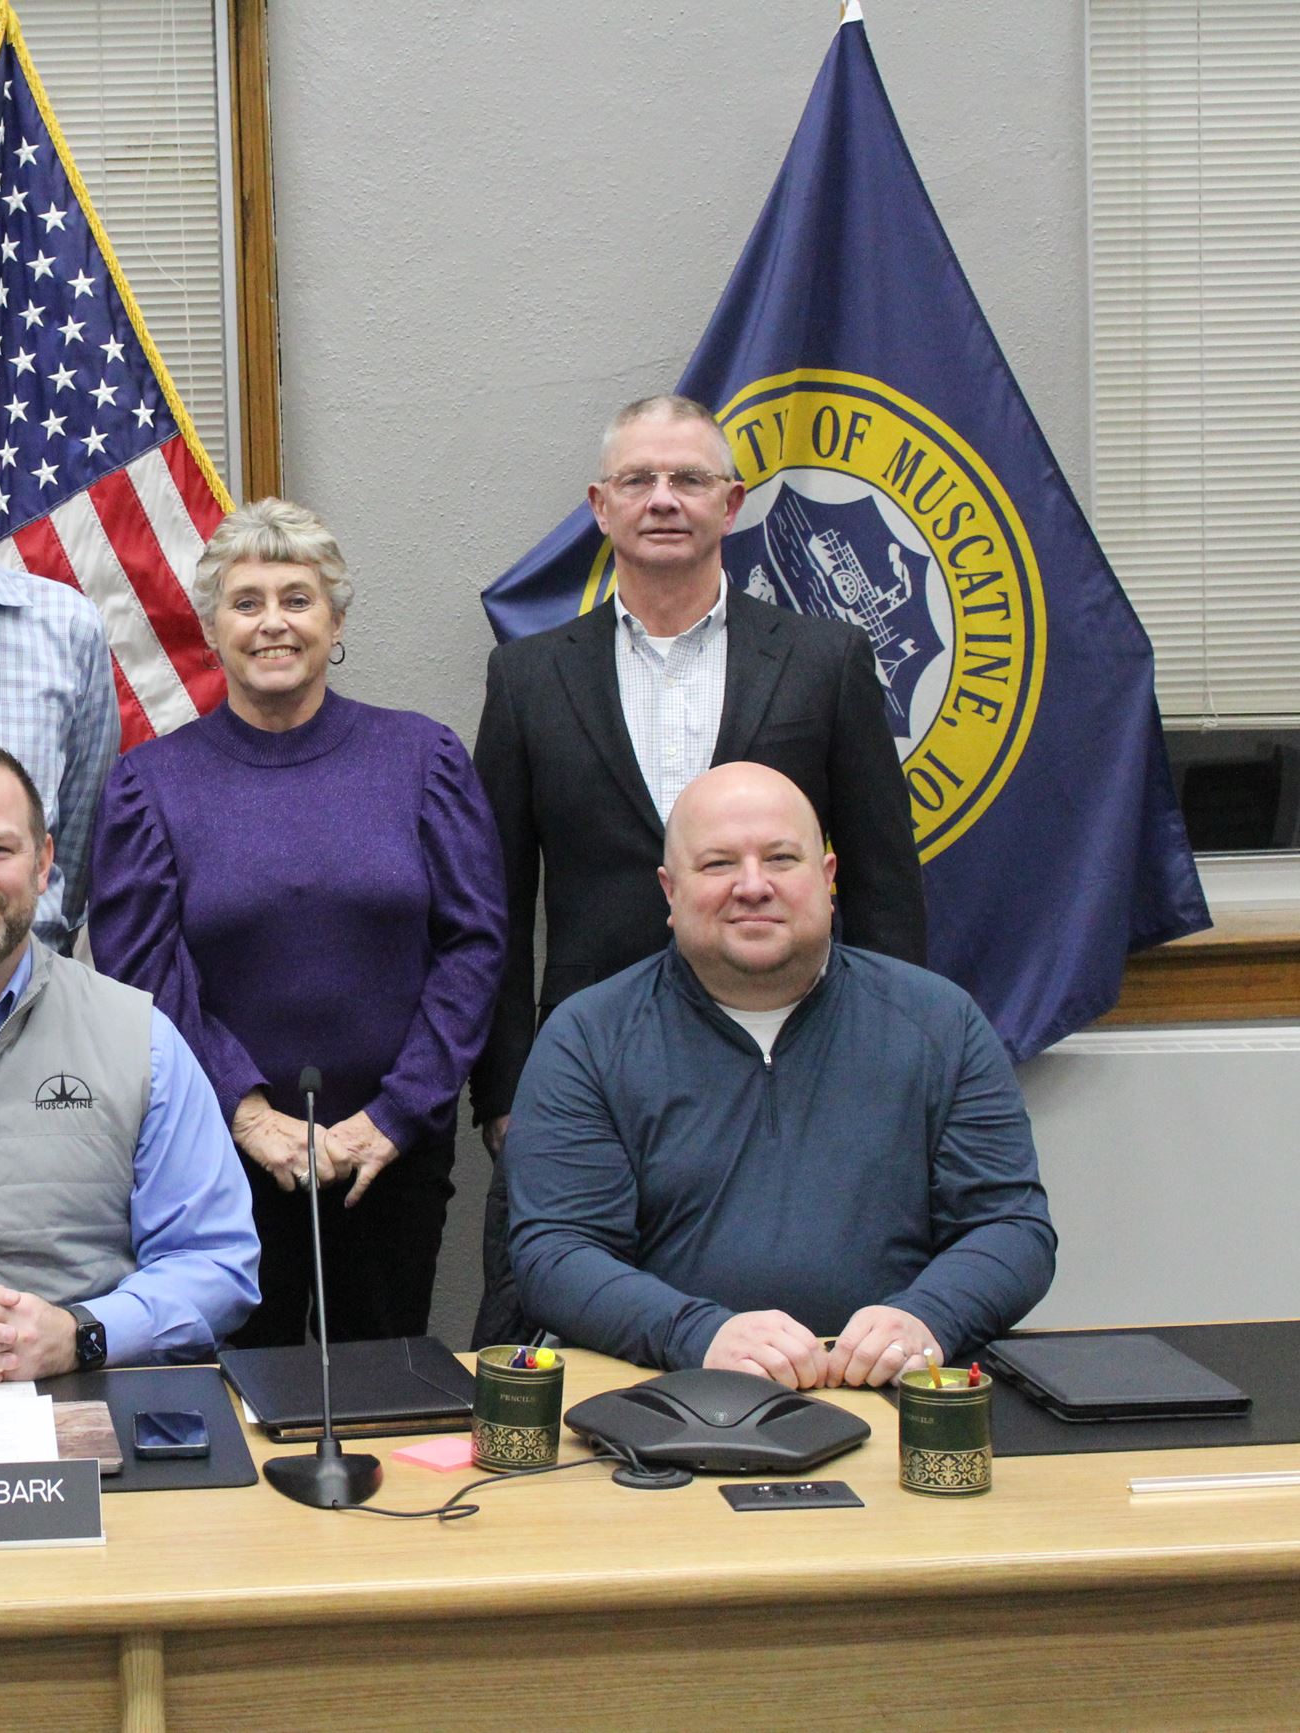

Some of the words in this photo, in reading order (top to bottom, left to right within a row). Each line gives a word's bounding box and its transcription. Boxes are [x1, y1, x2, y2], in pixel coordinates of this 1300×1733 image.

[736, 407, 790, 474] TY
[812, 405, 873, 463] OF
[881, 436, 1013, 728] MUSCATINE,
[906, 749, 965, 829] IO
[35, 1100, 93, 1111] MUSCATINE
